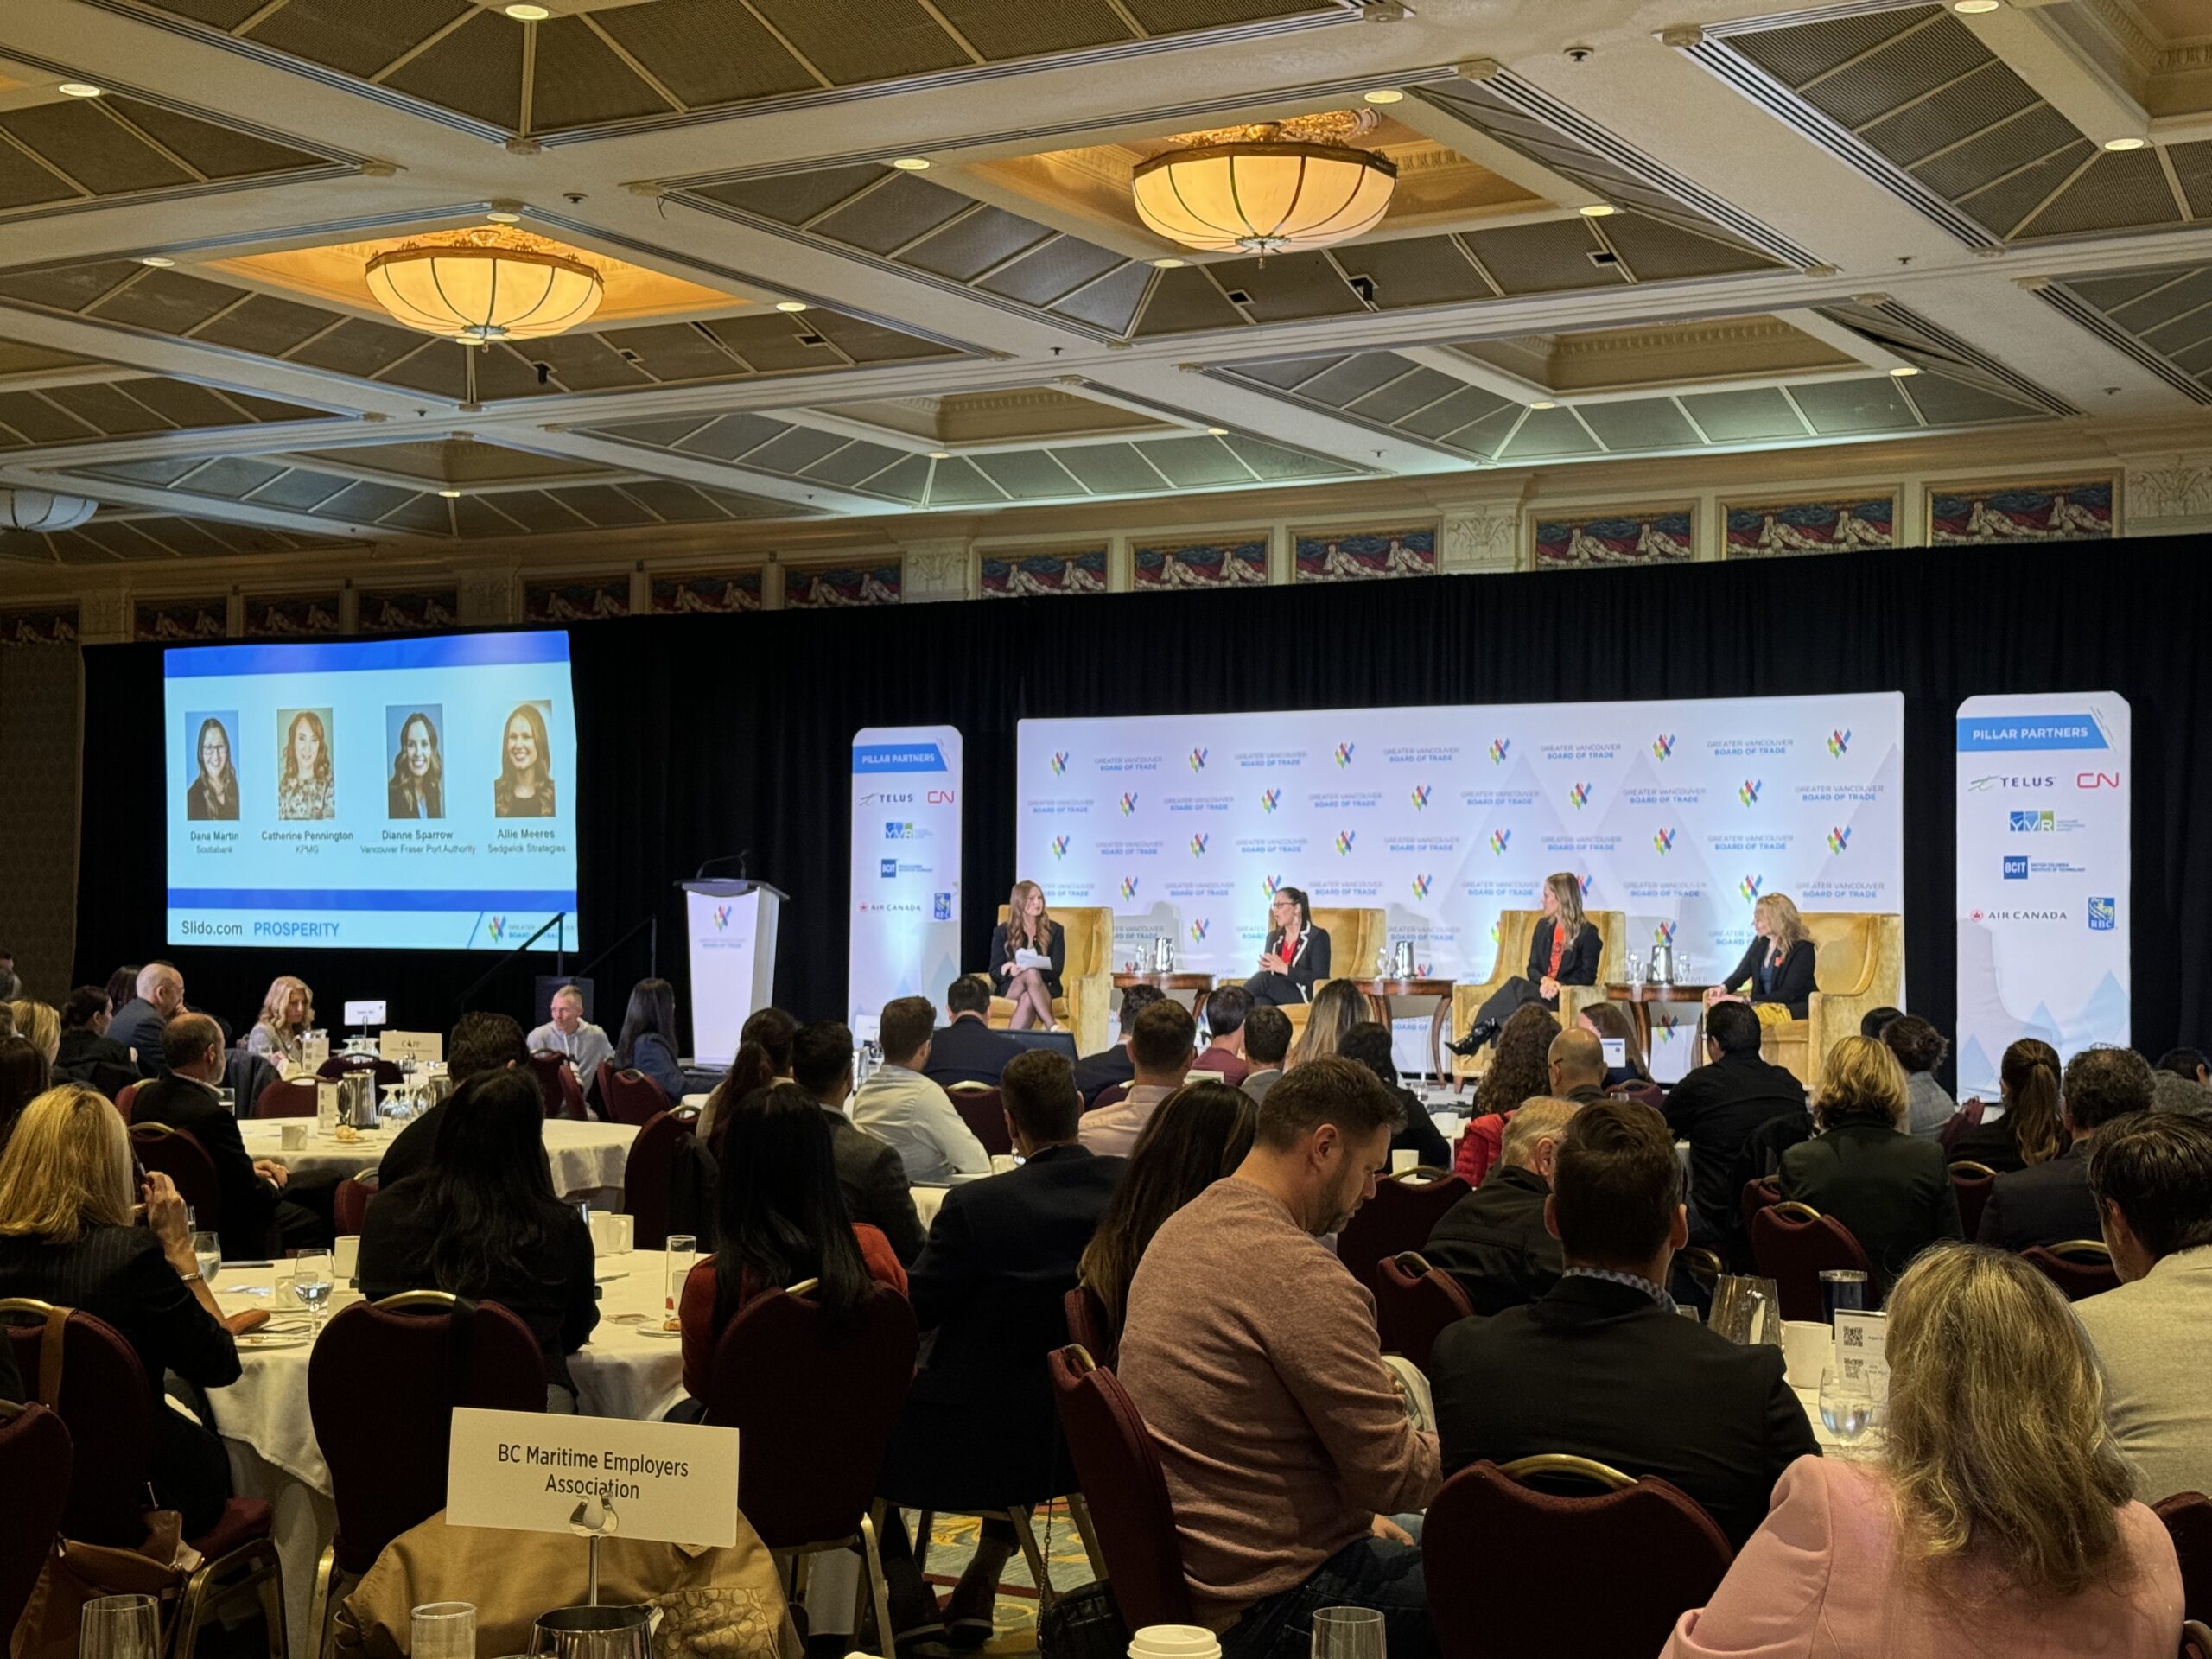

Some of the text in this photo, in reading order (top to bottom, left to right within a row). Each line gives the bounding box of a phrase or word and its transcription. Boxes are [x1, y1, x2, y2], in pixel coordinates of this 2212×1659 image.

[1973, 727, 2088, 740] PILLAR PARTNERS
[861, 753, 935, 764] PILLAR PARTNERS
[2000, 777, 2054, 787] TELUS
[2077, 772, 2120, 788] CN
[880, 794, 913, 803] TELUS
[927, 791, 954, 804] CN
[2010, 820, 2055, 832] YVR
[190, 831, 239, 841] Dana Martin
[261, 831, 353, 842] Catherine Pennington
[382, 830, 454, 841] Dianne Sparrow
[498, 830, 555, 839] Allie Meeres
[2005, 861, 2026, 874] BCIT
[2013, 911, 2067, 919] CANADA
[181, 920, 340, 937] Slido.com PROSPERITY
[2090, 919, 2113, 929] RBC
[498, 1444, 689, 1478] BC Maritime Employers
[545, 1474, 639, 1499] Association
